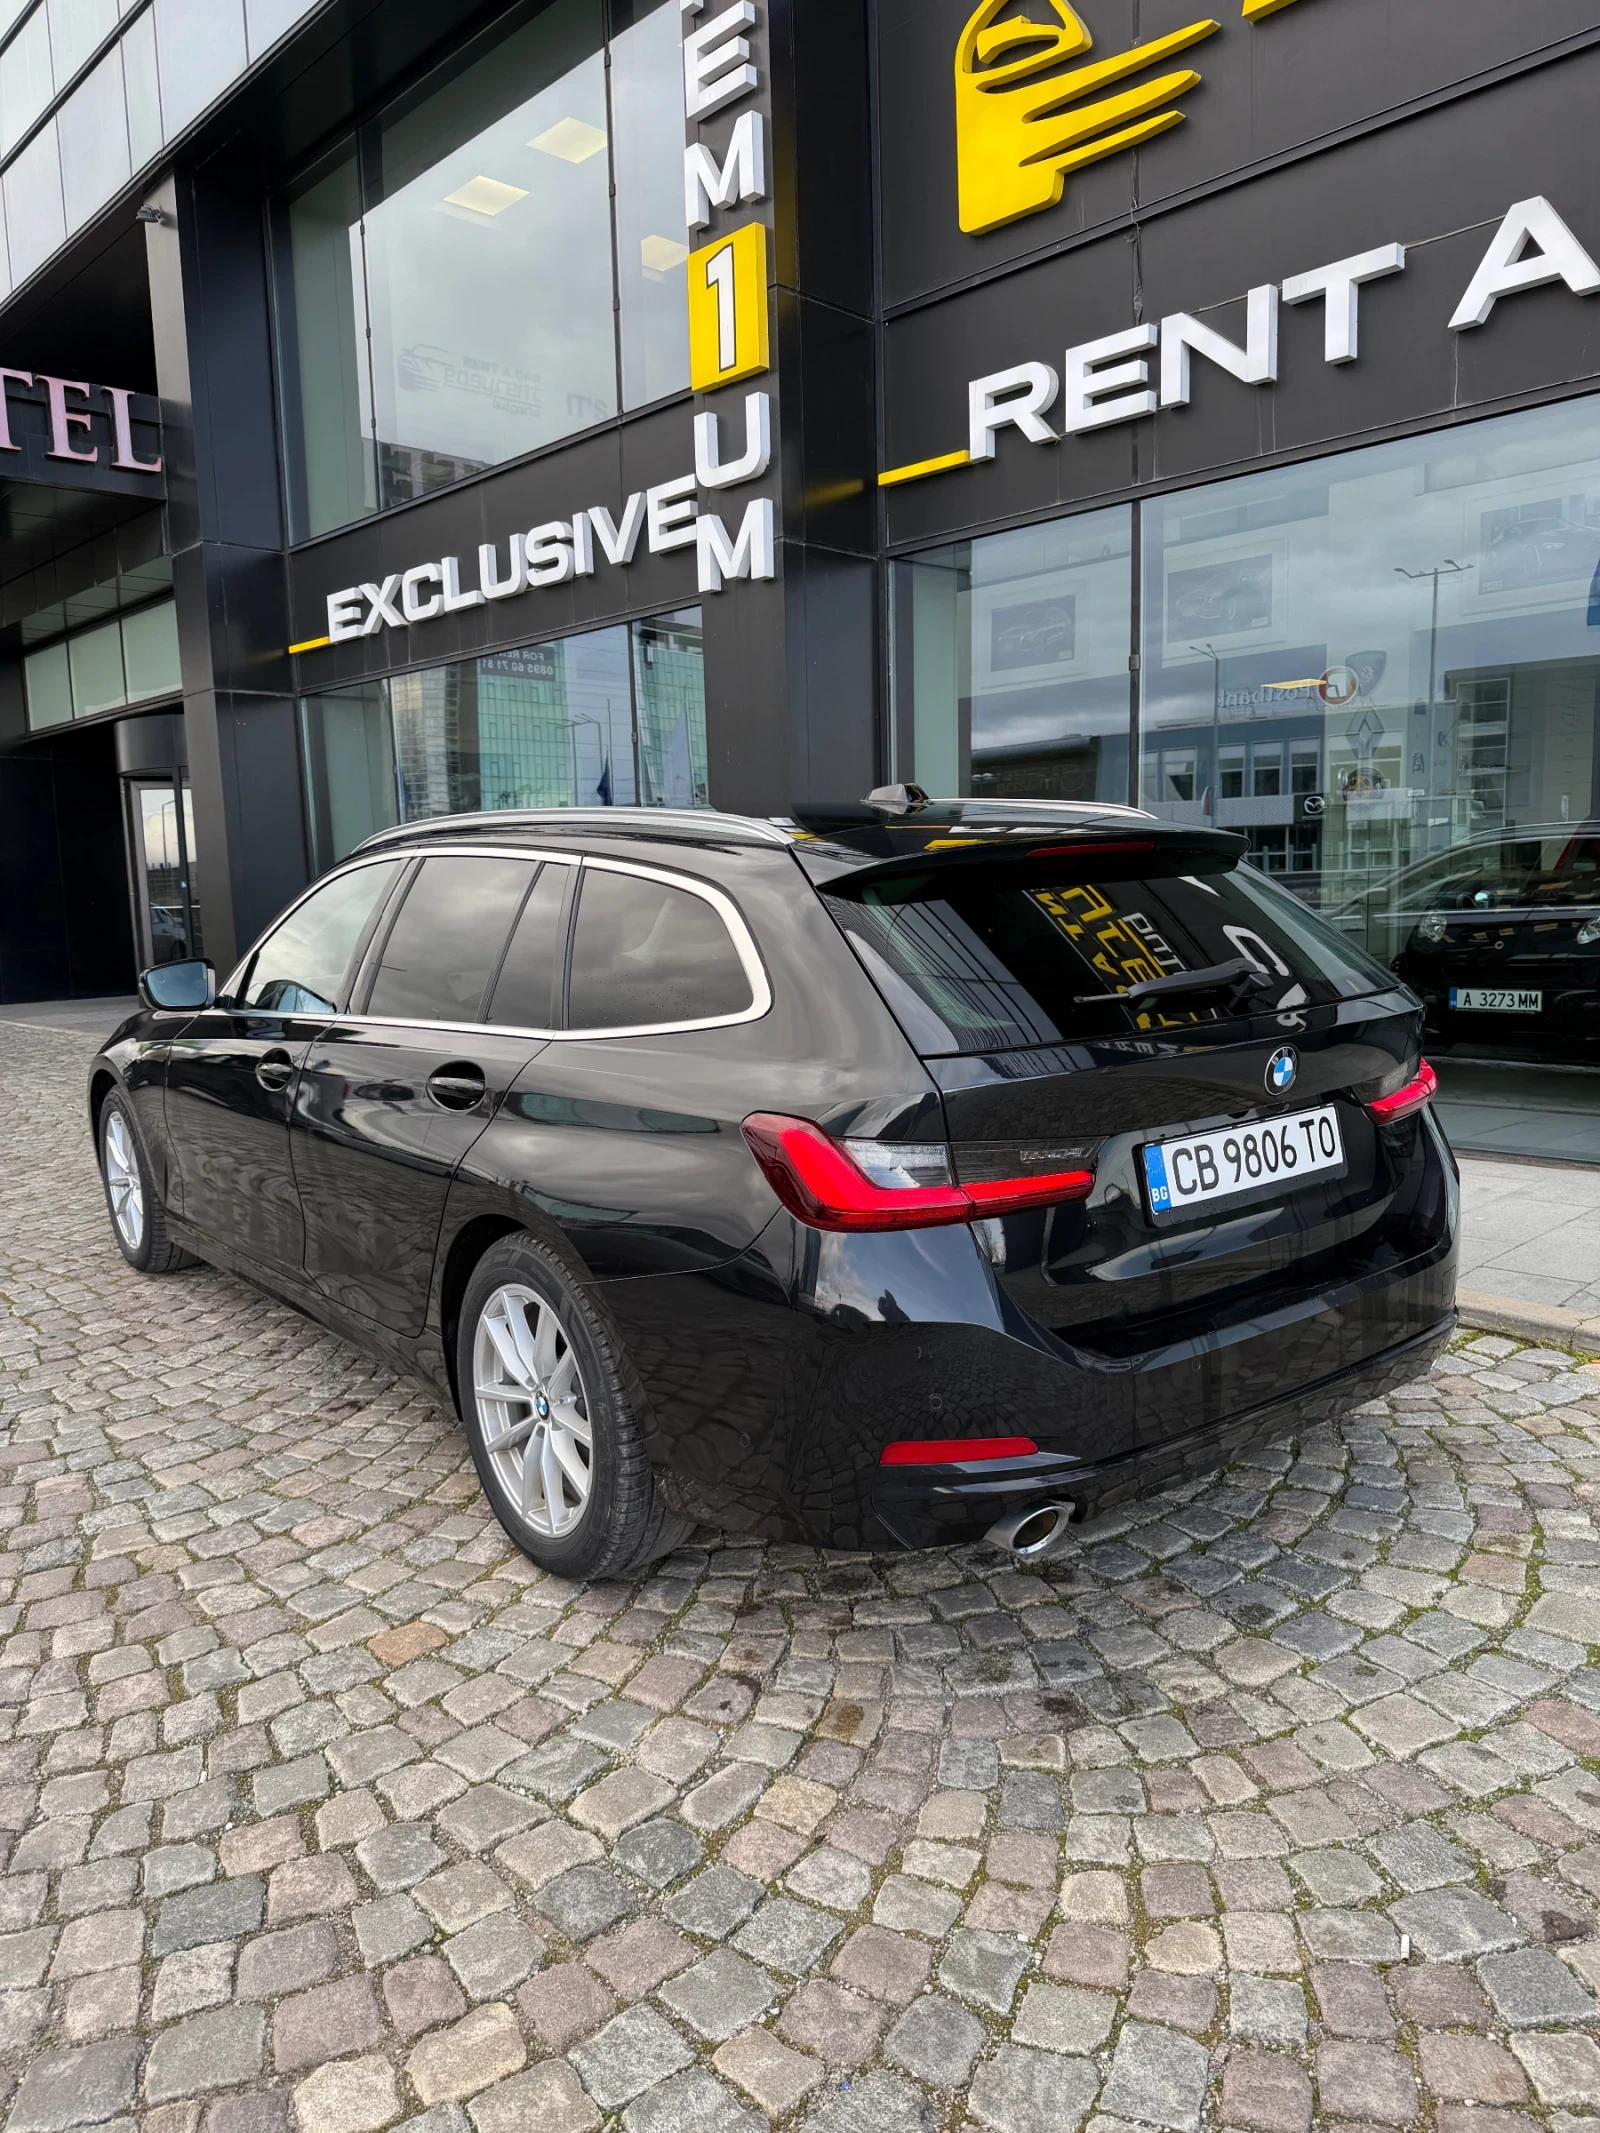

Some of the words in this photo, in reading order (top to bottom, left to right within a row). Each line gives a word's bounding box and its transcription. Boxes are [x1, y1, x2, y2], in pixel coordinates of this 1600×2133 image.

[682, 0, 774, 593] EM1UM
[968, 242, 1406, 464] RENT
[1447, 195, 1600, 333] A
[327, 473, 698, 643] EXCLUSIVE
[1463, 991, 1472, 1007] A
[1479, 992, 1516, 1008] 3273
[1518, 993, 1539, 1009] MM
[1150, 1185, 1169, 1203] BG
[1172, 1143, 1220, 1196] CB
[1223, 1125, 1298, 1184] 9806
[1299, 1116, 1336, 1163] TO
